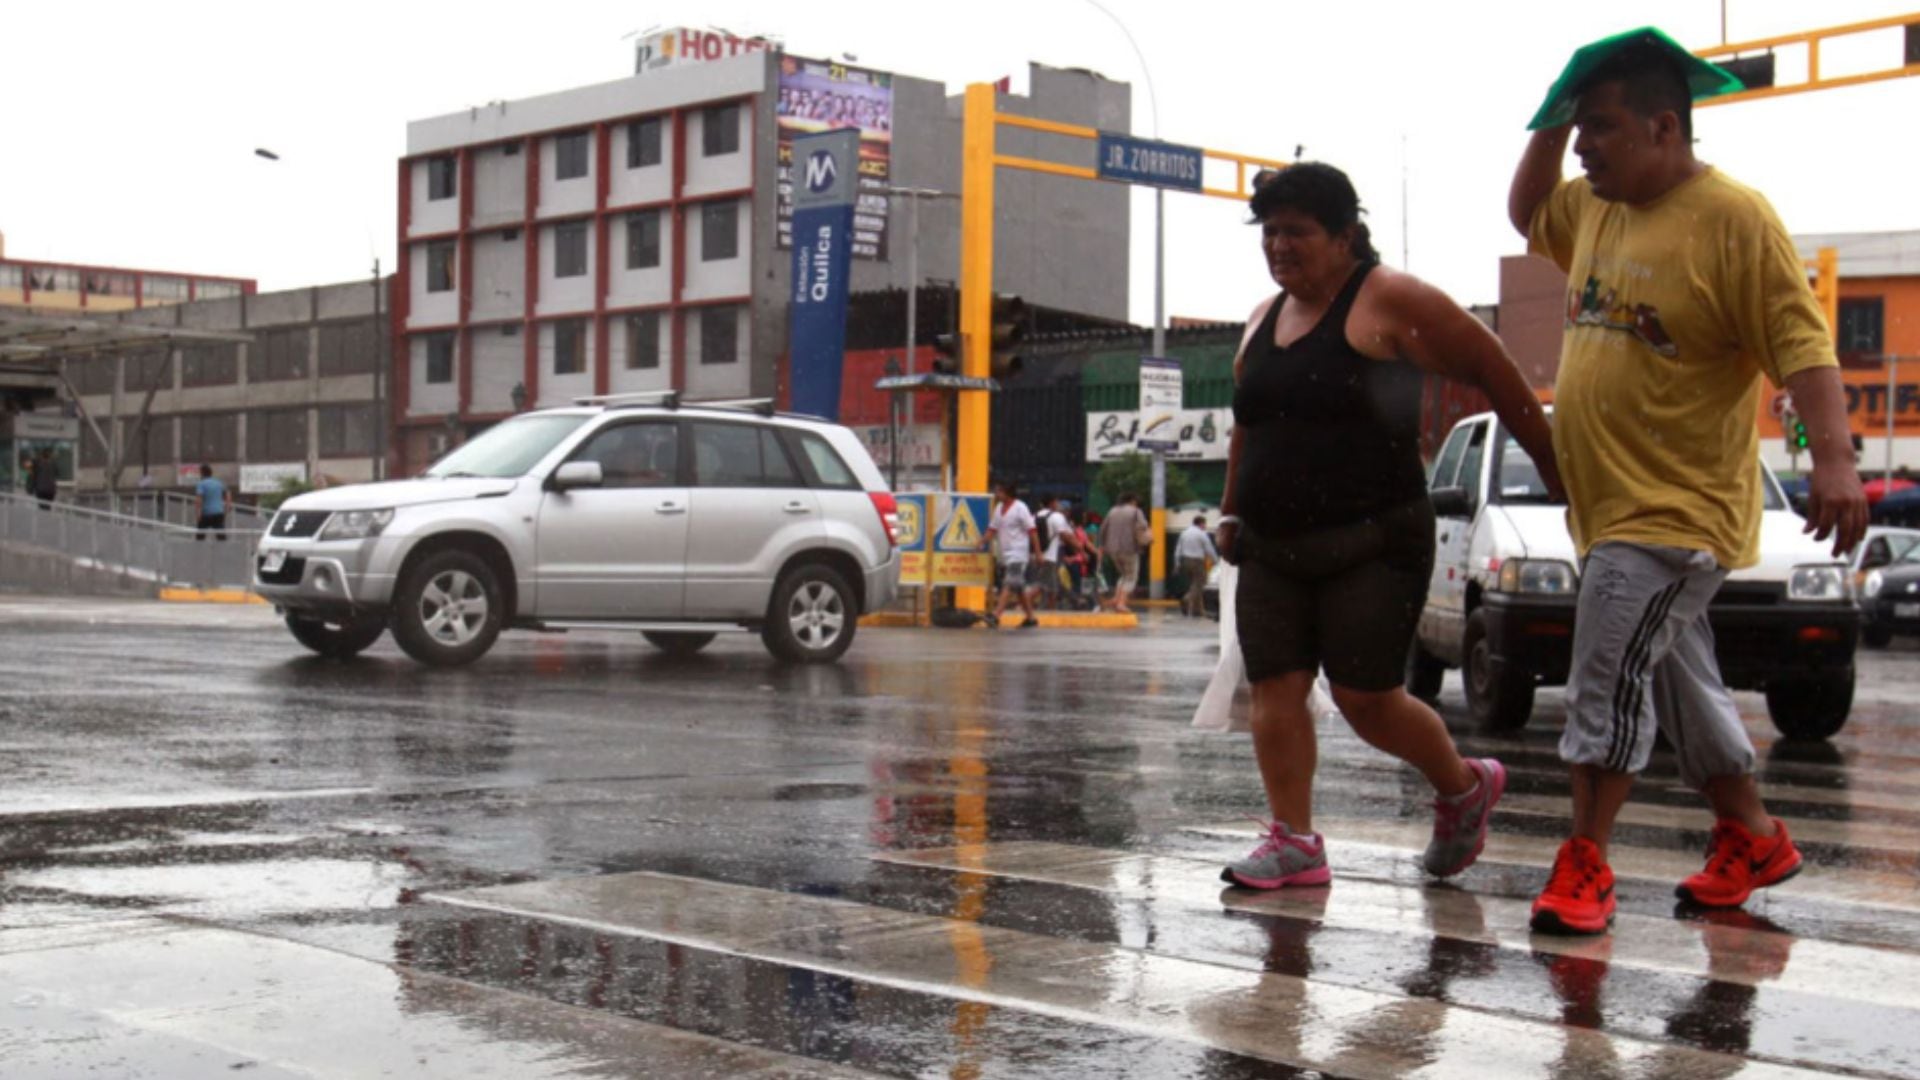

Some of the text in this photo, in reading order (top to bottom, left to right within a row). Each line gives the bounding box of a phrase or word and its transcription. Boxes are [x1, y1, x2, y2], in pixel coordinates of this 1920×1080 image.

[680, 28, 772, 61] HOTE
[1106, 145, 1196, 179] JR. ZORRITOS
[811, 225, 831, 301] Quilca
